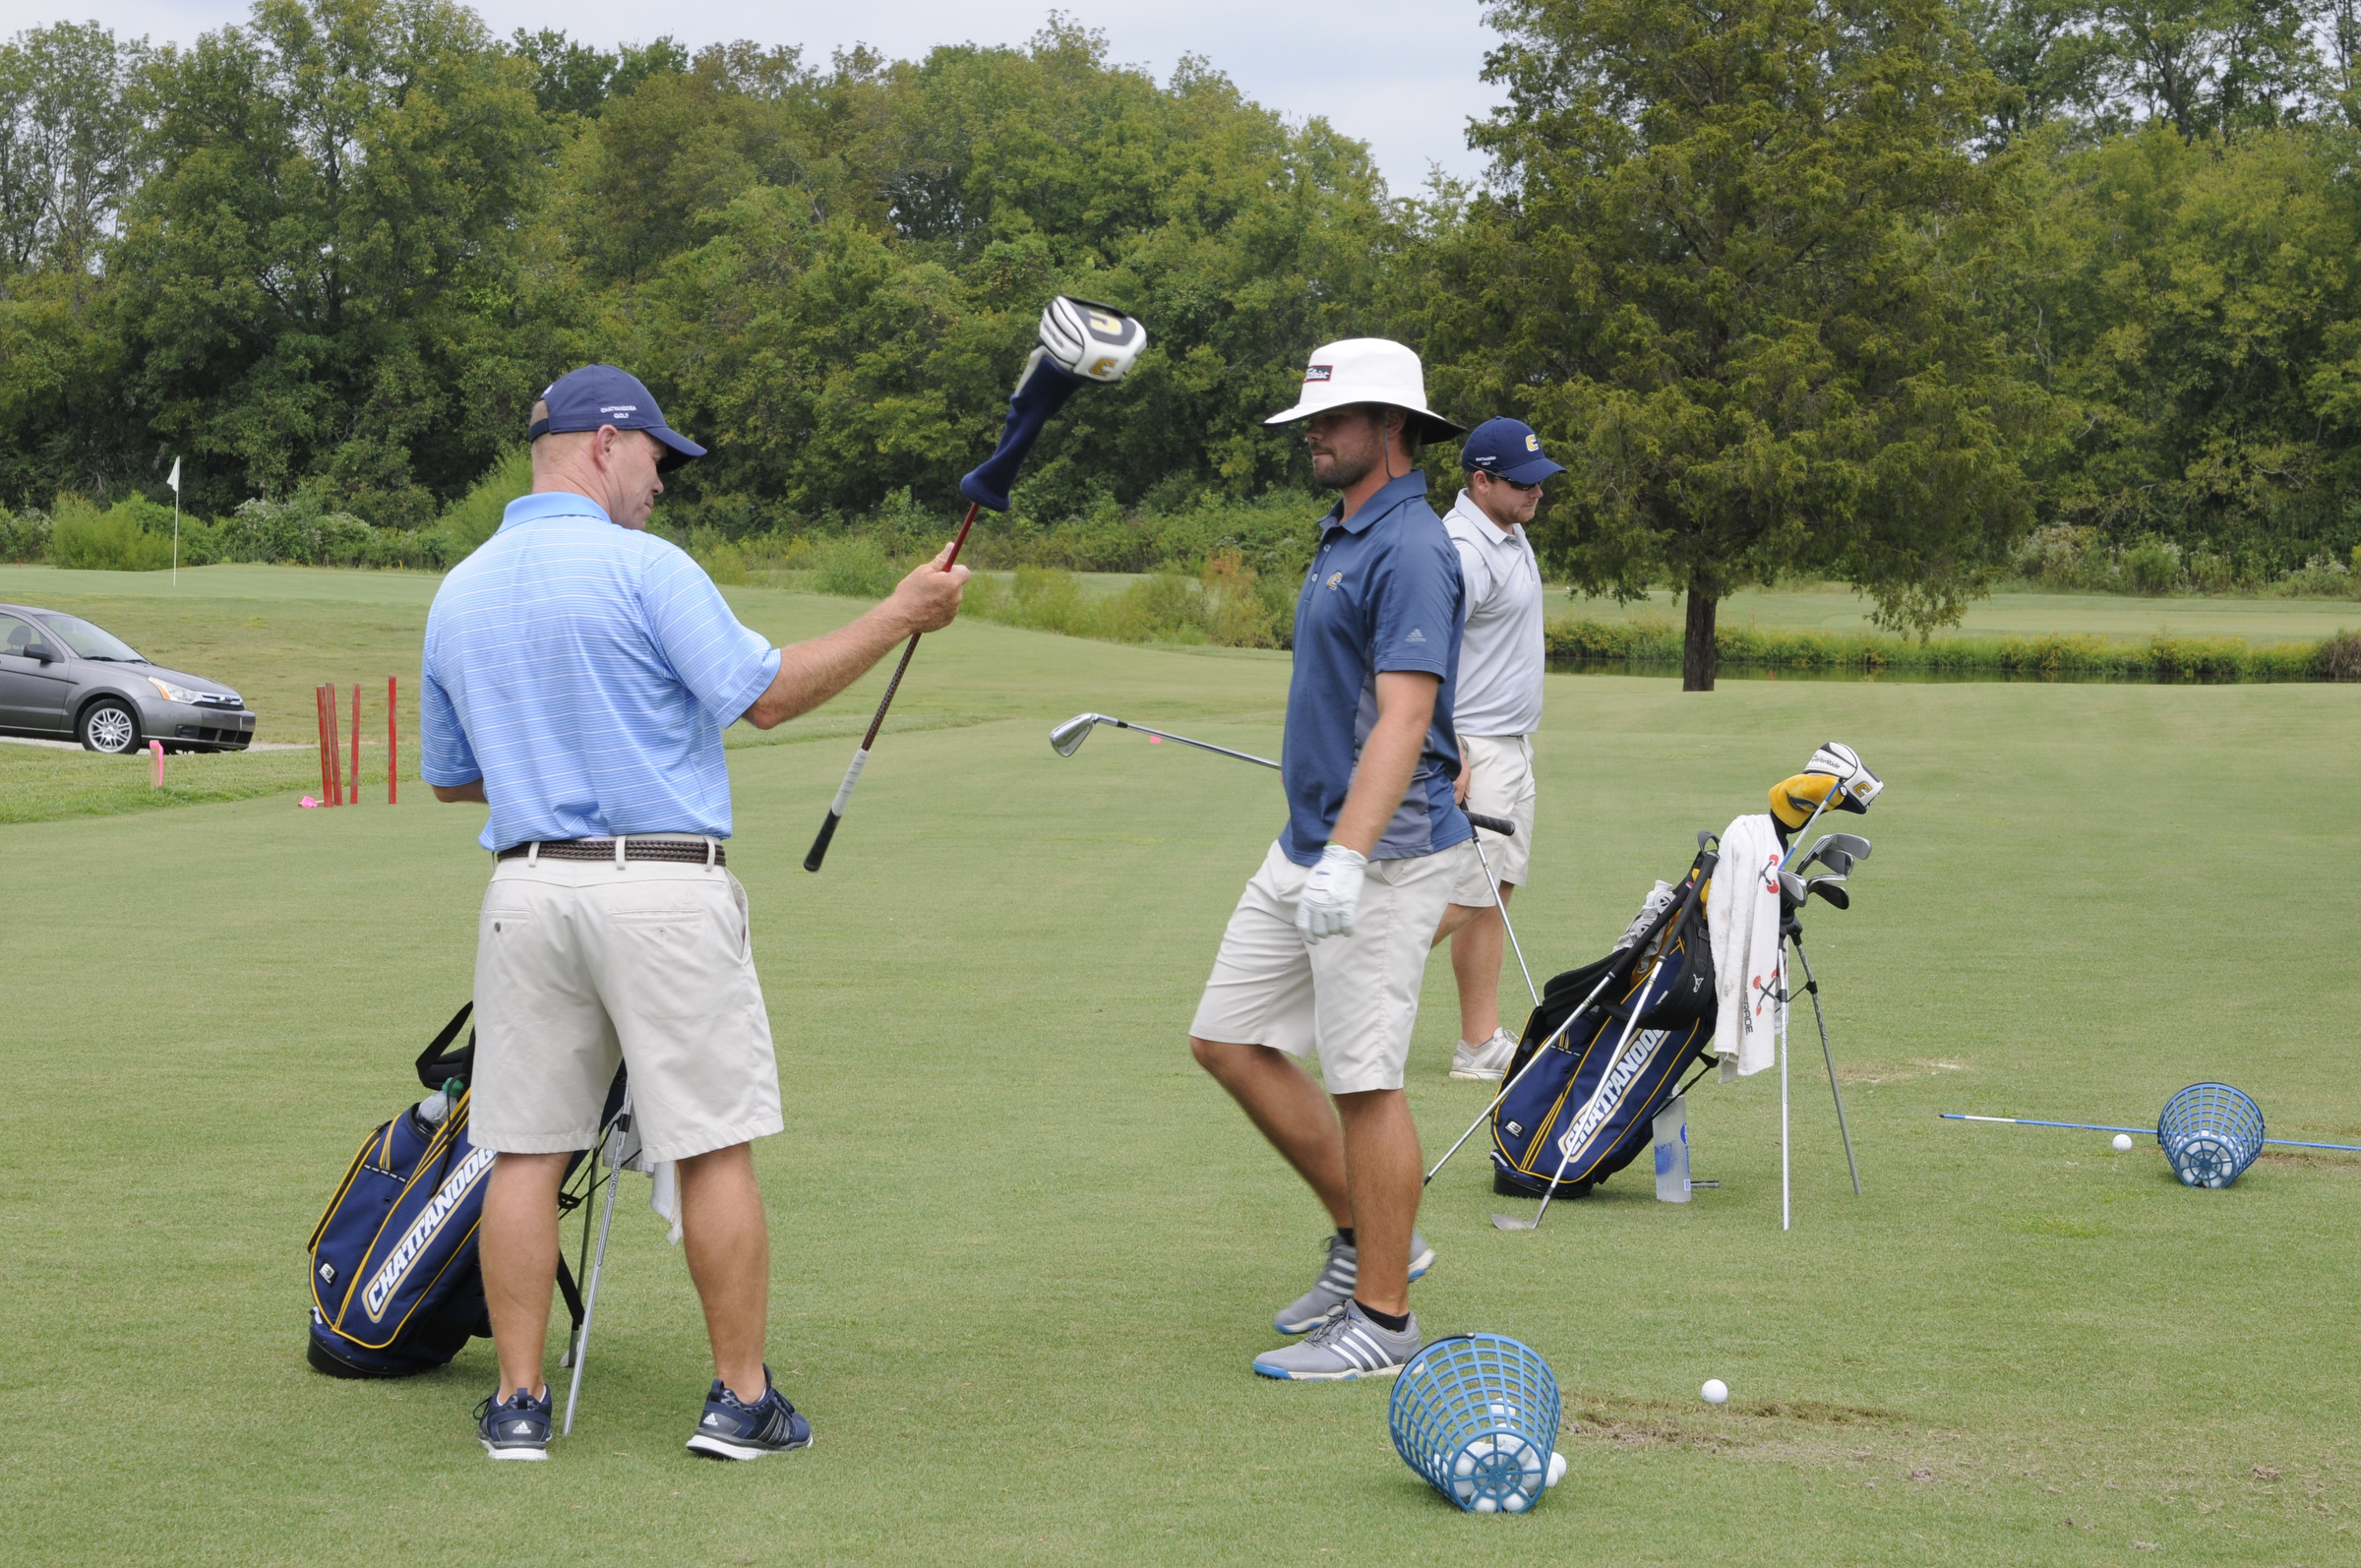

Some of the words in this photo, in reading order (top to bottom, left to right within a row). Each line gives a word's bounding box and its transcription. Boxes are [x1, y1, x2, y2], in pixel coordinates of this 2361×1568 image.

[1525, 434, 1540, 452] C
[1326, 572, 1343, 590] C
[1852, 781, 1873, 798] C
[1565, 1029, 1665, 1155] CHATTANOO
[368, 1147, 498, 1312] CHATTANOOG
